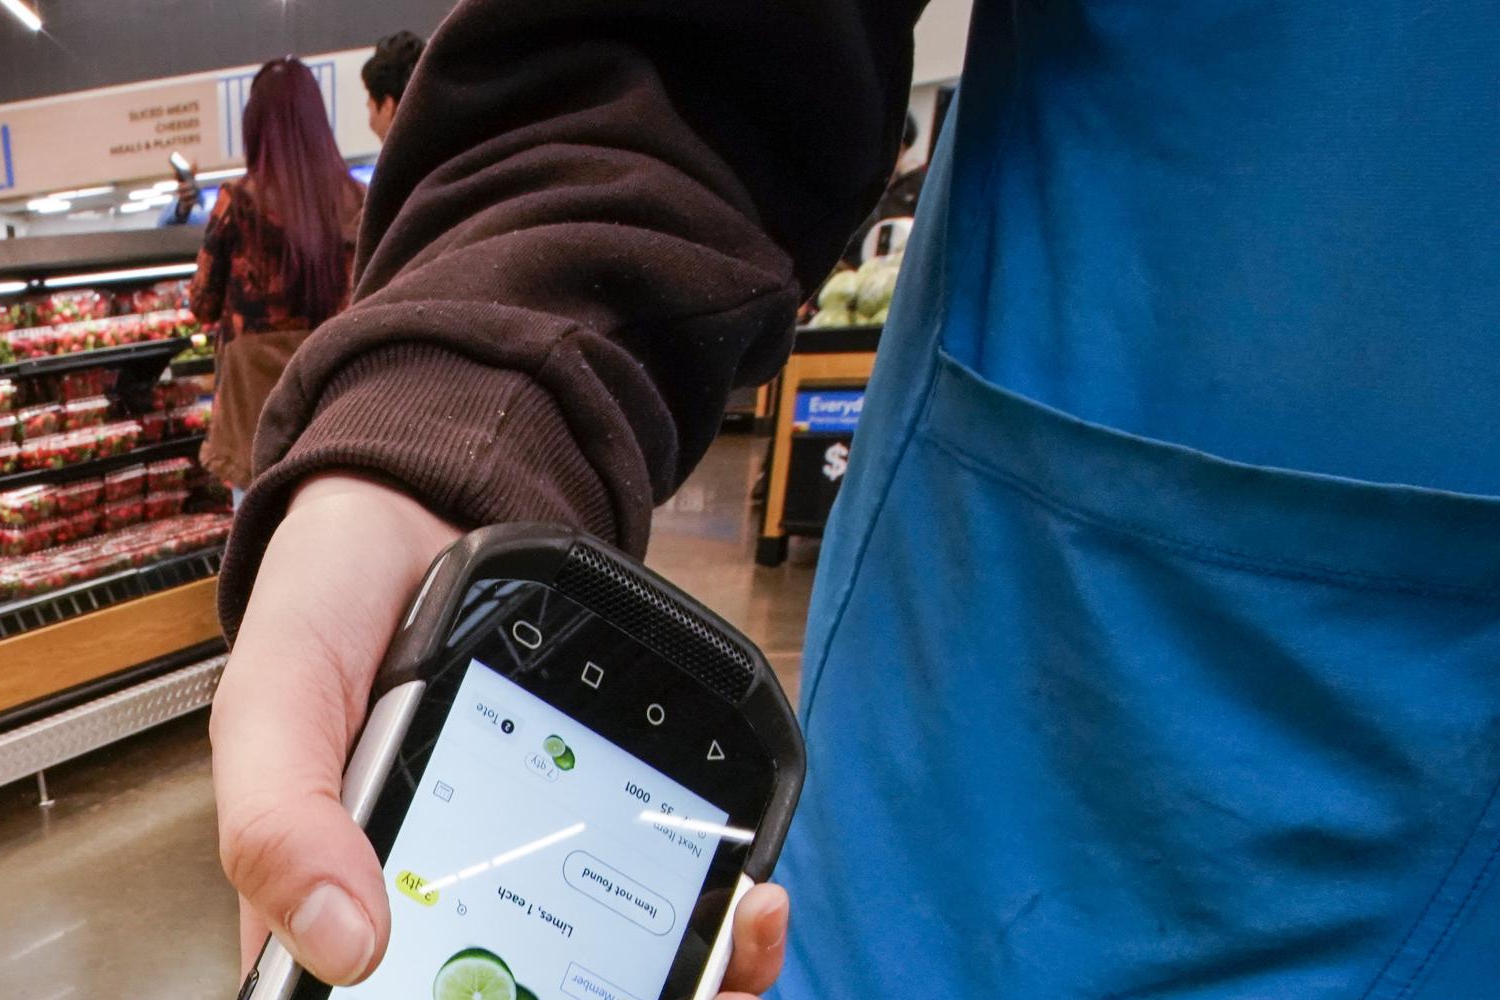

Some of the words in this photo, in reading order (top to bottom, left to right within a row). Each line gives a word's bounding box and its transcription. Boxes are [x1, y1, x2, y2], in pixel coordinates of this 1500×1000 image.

[475, 702, 499, 725] Tote
[529, 753, 547, 770] qty
[624, 780, 651, 804] 0001
[677, 835, 702, 858] Next
[580, 866, 613, 893] found
[496, 885, 526, 907] each
[614, 885, 633, 901] not
[526, 902, 533, 915] 1
[633, 896, 658, 919] Item
[537, 905, 574, 938] Limes,
